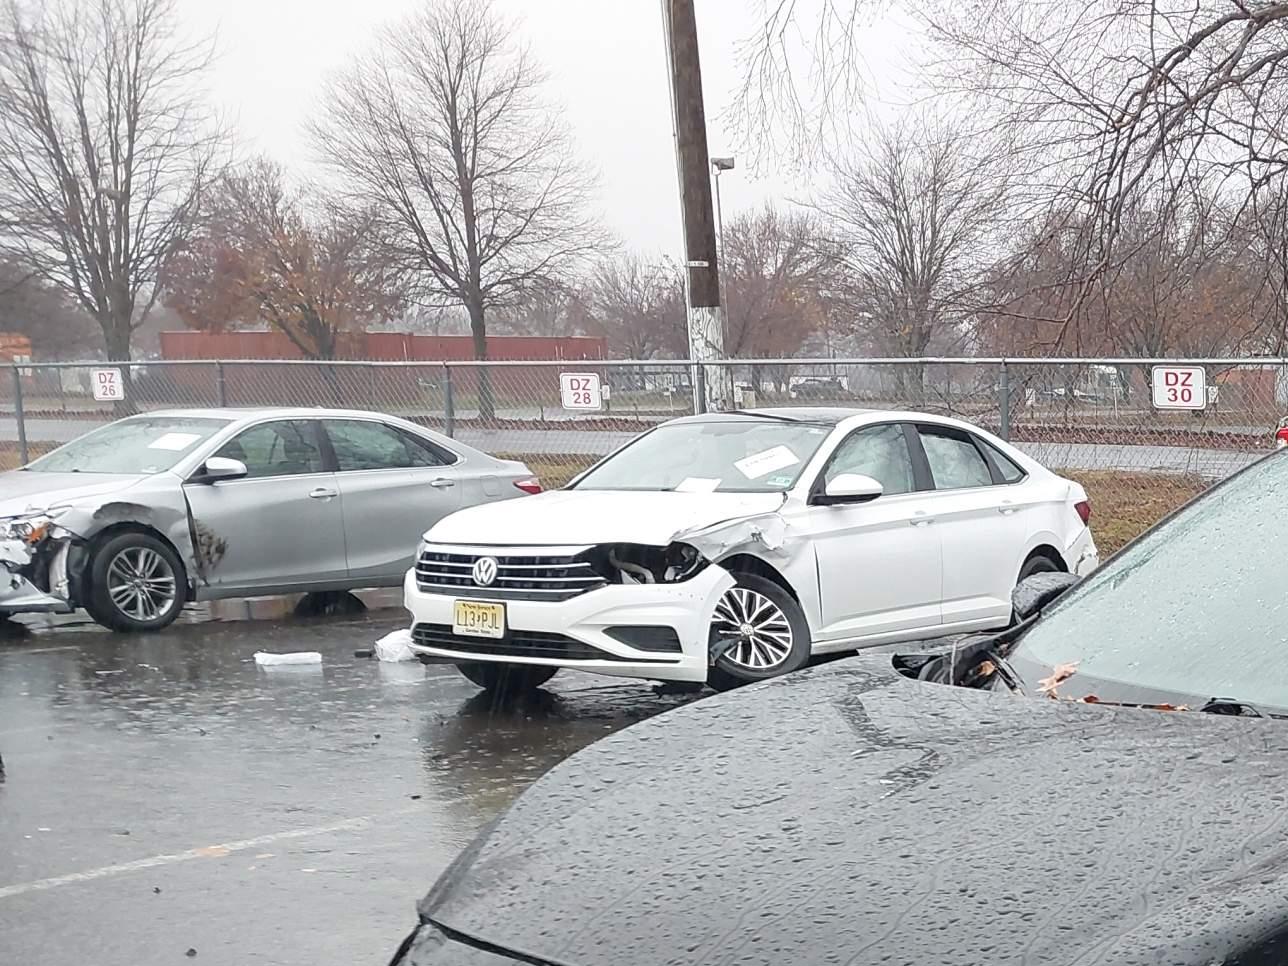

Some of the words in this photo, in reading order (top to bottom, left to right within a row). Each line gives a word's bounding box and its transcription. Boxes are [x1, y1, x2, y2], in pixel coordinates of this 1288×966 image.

[98, 372, 115, 384] DZ
[569, 378, 591, 391] DZ
[1164, 371, 1193, 387] DZ
[101, 385, 116, 396] 26
[1167, 387, 1192, 403] 30
[572, 392, 592, 405] 28
